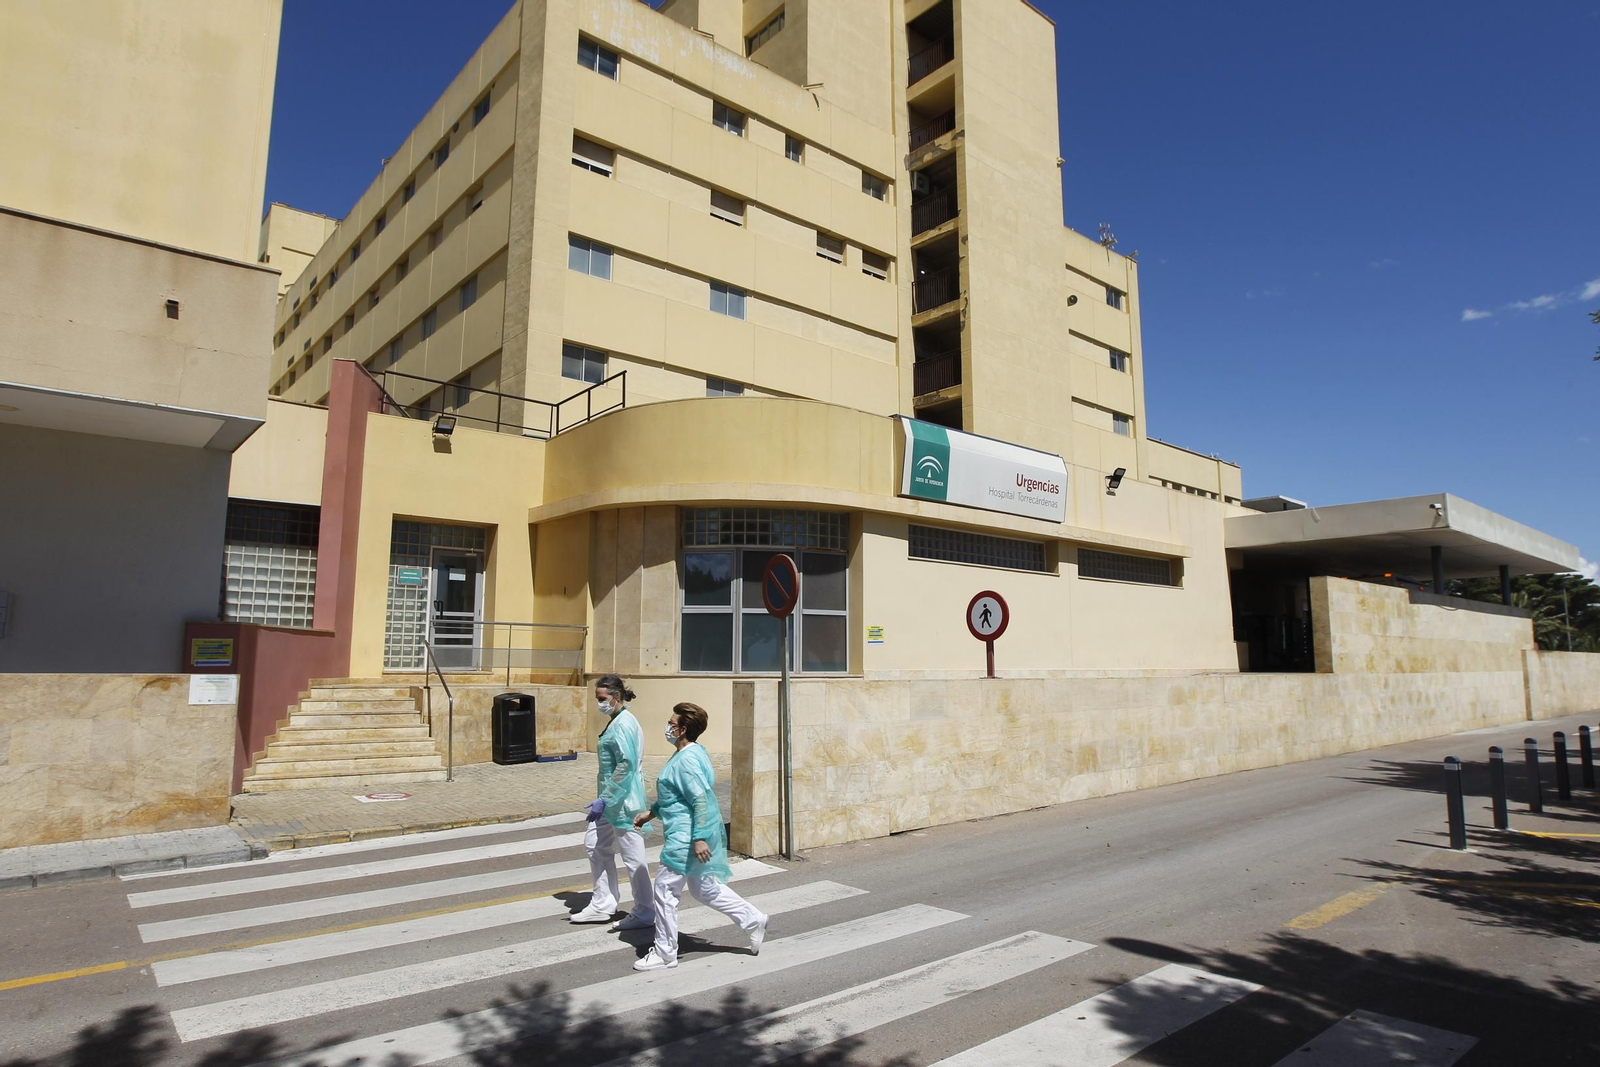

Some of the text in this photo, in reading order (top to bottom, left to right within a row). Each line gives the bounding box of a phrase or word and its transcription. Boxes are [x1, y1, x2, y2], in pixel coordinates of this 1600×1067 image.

[1016, 473, 1059, 494] Urgencias
[988, 486, 1059, 508] Hospital Torrecárdenas
